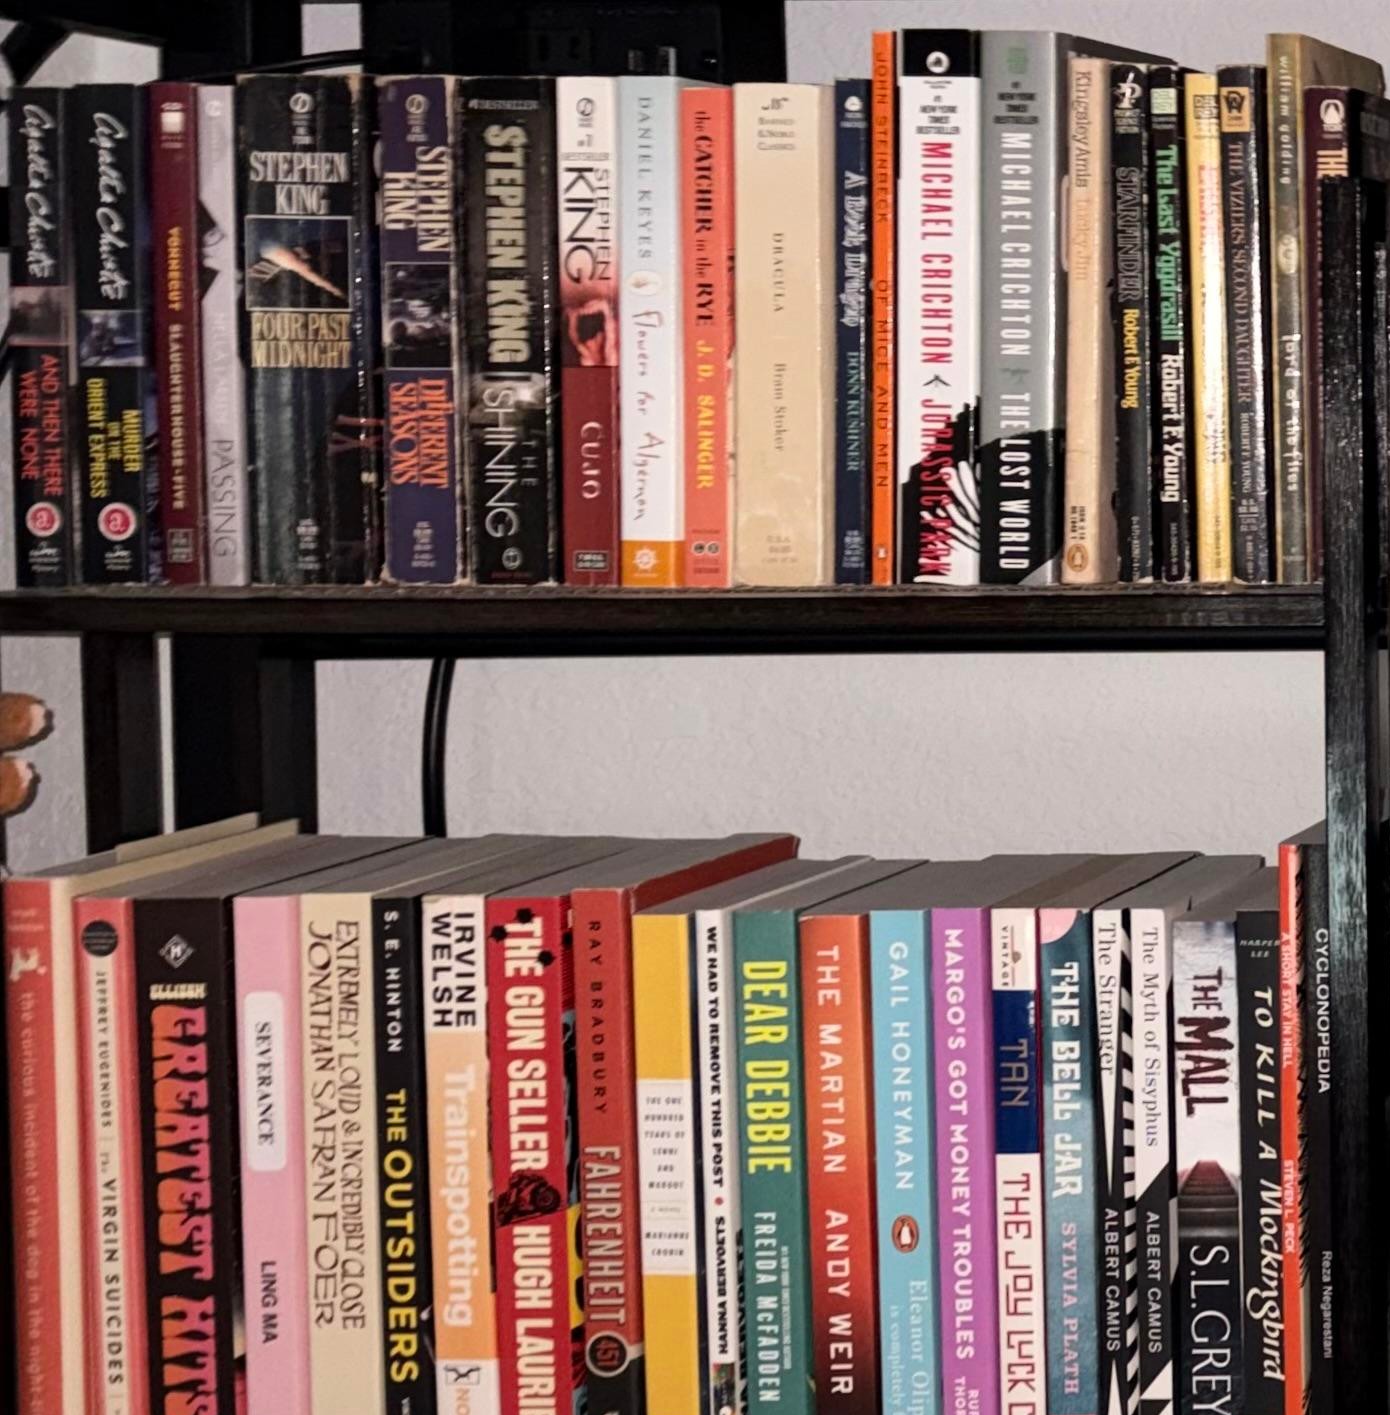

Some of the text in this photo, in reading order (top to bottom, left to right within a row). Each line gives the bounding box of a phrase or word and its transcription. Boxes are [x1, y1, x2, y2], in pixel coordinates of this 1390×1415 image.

[250, 152, 349, 183] STEPHEN
[274, 185, 329, 214] KING
[1001, 133, 1032, 368] MICHAEL CRICHTON
[581, 421, 601, 498] CUJO
[877, 280, 888, 488] OF MICE AND MEN
[1000, 393, 1030, 571] THE LOST WORLD
[432, 913, 452, 1028] WELSH
[455, 913, 475, 1028] IRVINE
[505, 918, 548, 1174] THE GUN SELLER
[1316, 928, 1330, 1094] CYCLONOPEDIA
[256, 1021, 274, 1146] SEVERANCE
[743, 962, 792, 1174] DEAR DEBBIE
[816, 947, 846, 1174] THE MARTIAN
[1050, 961, 1081, 1197] THE BELL JAR
[384, 1090, 419, 1383] THE OUTSIDERS
[442, 1067, 480, 1328] Trainspotting
[512, 1225, 551, 1312] HUGH
[585, 1146, 625, 1326] FAHRENHEIT
[1104, 1209, 1119, 1351] ALBERT CAMUS
[261, 1261, 278, 1344] LING MA
[825, 1210, 852, 1395] ANDY WEIR
